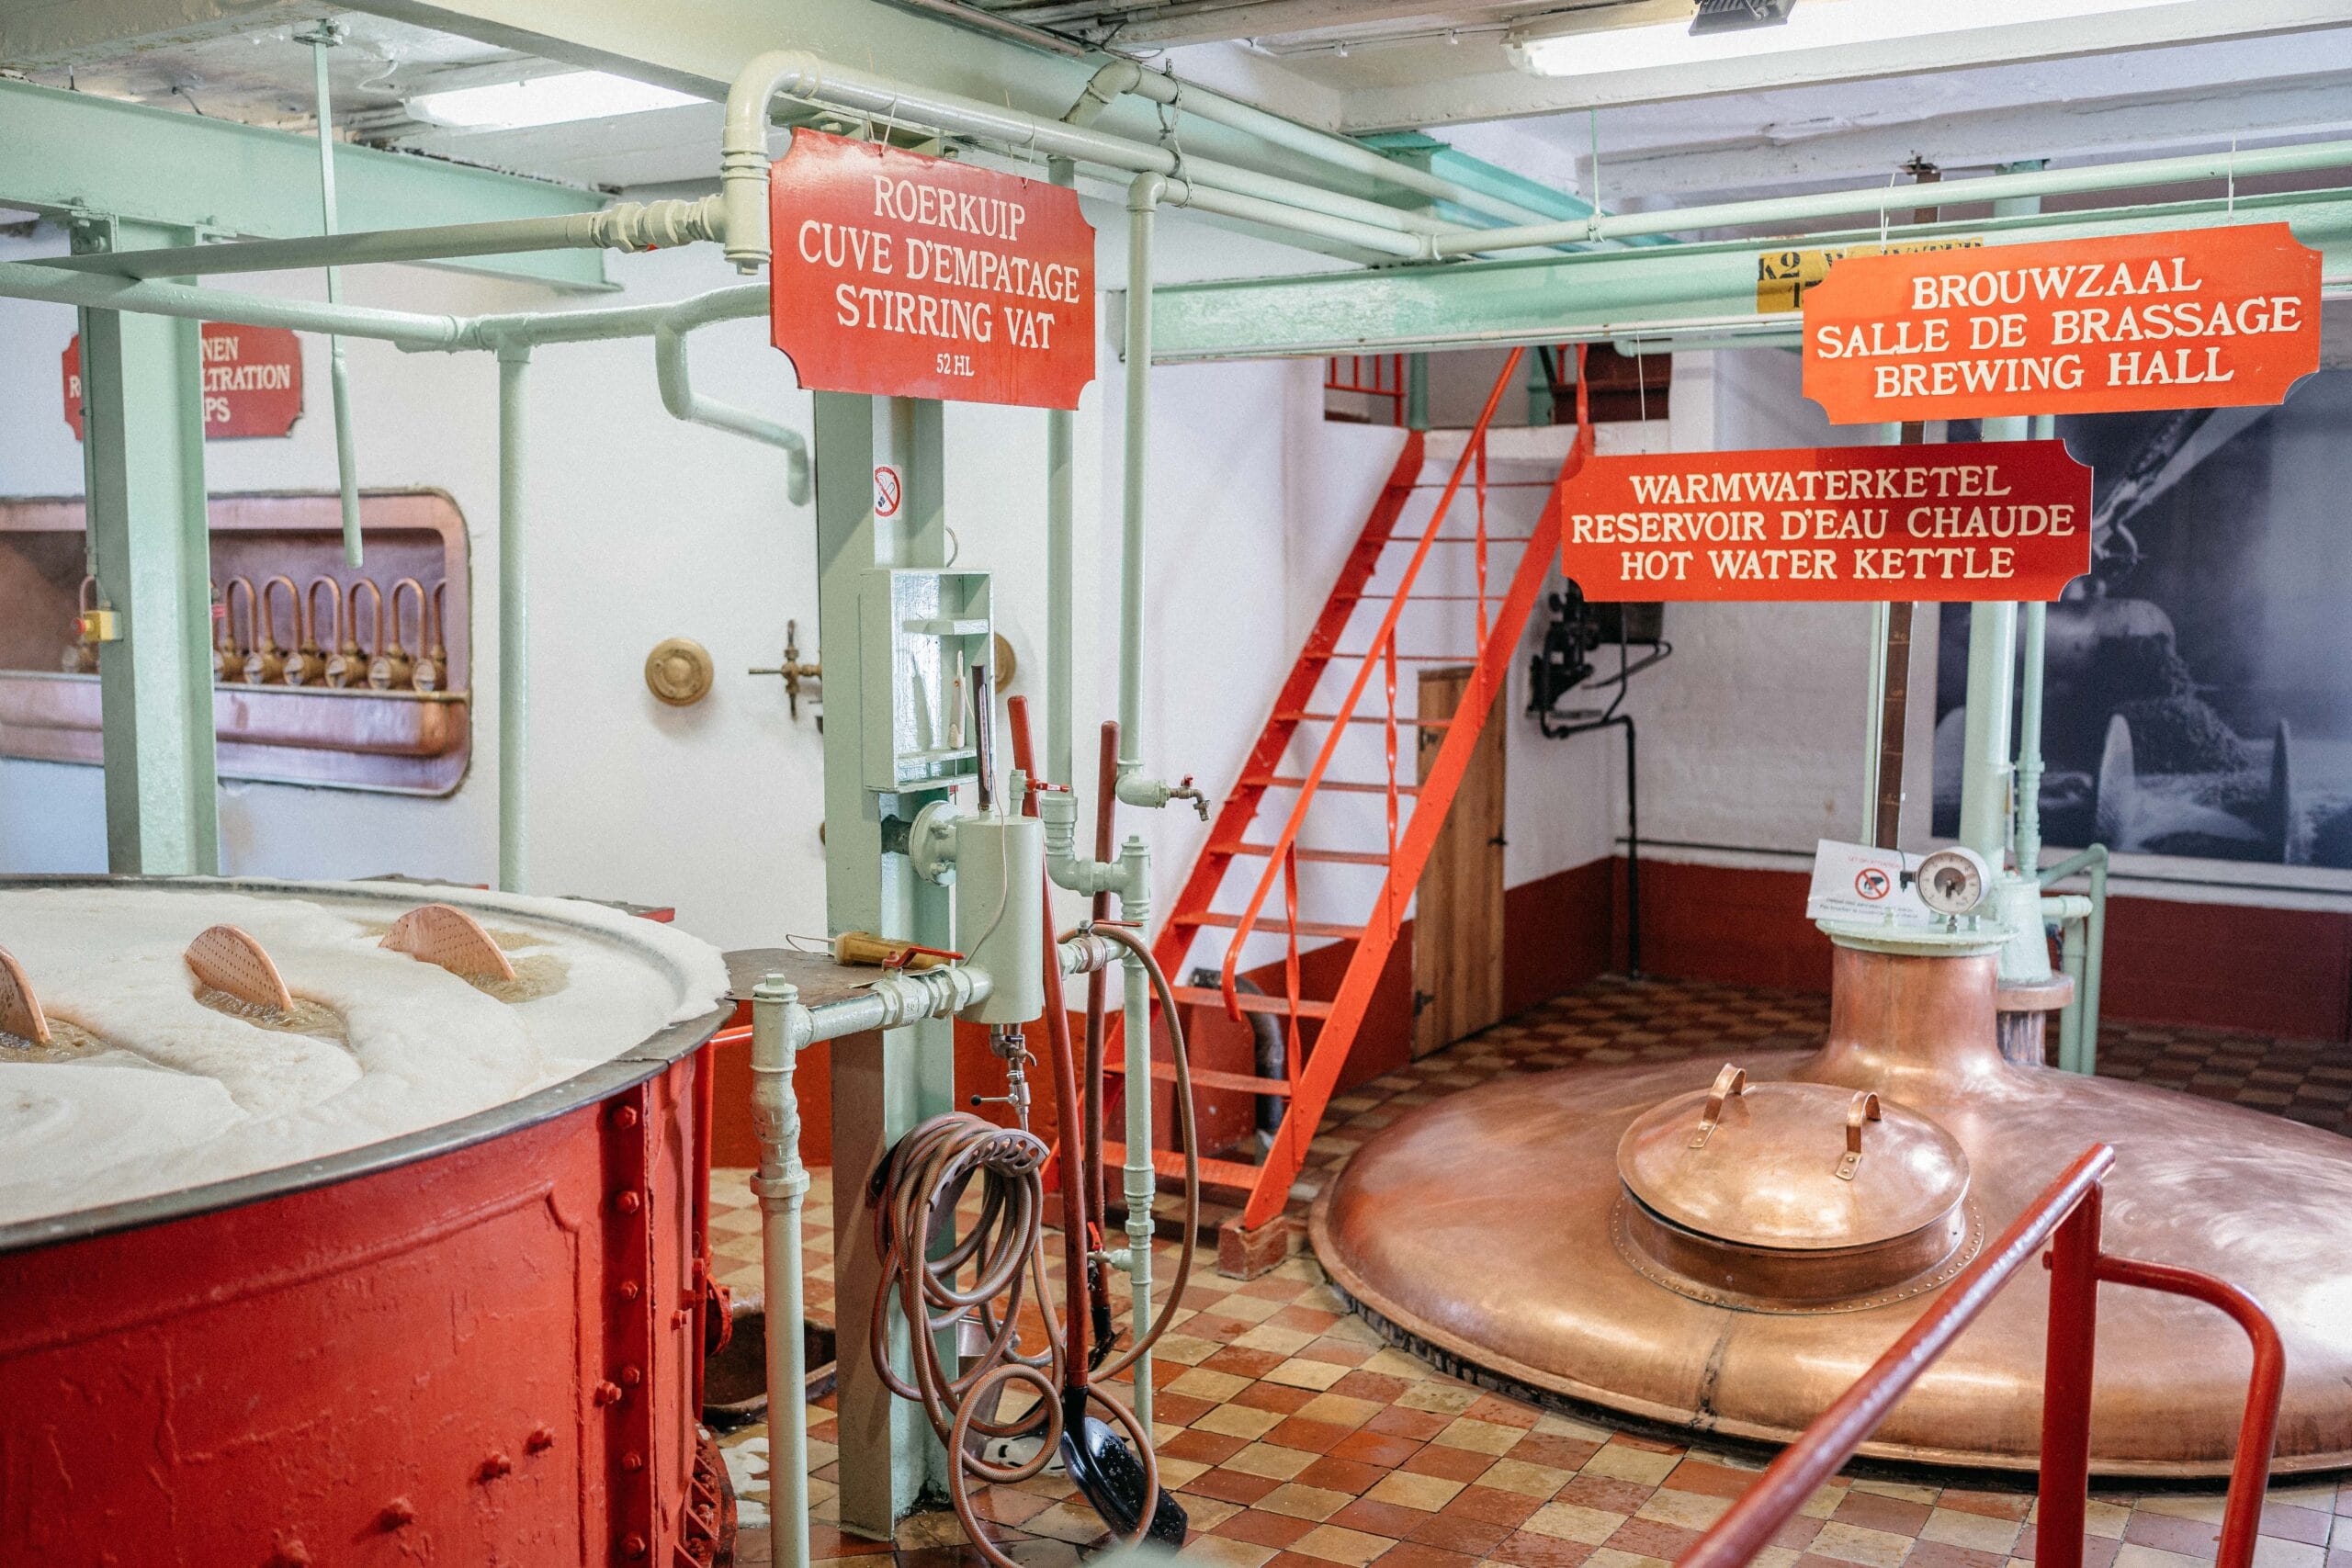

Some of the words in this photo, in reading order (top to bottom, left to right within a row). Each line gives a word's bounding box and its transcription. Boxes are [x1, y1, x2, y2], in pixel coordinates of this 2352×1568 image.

[874, 175, 1025, 242] ROERKUIP
[798, 220, 893, 275] CUVE
[905, 237, 1080, 304] D'EMPATAGE
[1911, 256, 2202, 310] BROUWZAAL
[835, 283, 992, 343] STIRRING
[1003, 307, 1056, 349] VAT
[1816, 318, 1950, 359] SALLE
[1969, 313, 2028, 350] DE
[2051, 296, 2301, 345] BRASSAGE
[202, 336, 239, 362] NEN
[936, 353, 952, 375] 52
[953, 355, 975, 377] HL
[203, 365, 291, 392] LTRATION
[1873, 354, 2083, 399] BREWING
[2107, 346, 2235, 387] HALL
[205, 397, 231, 423] PS
[1628, 465, 2012, 505] WARMWATERKETEL
[1571, 511, 1767, 544] RESERVOIR
[1780, 508, 1889, 541] D'EAU
[1906, 504, 2075, 538] CHAUDE
[1620, 549, 1694, 581] HOT
[1706, 548, 1838, 581] WATER
[1852, 547, 2015, 580] KETTLE
